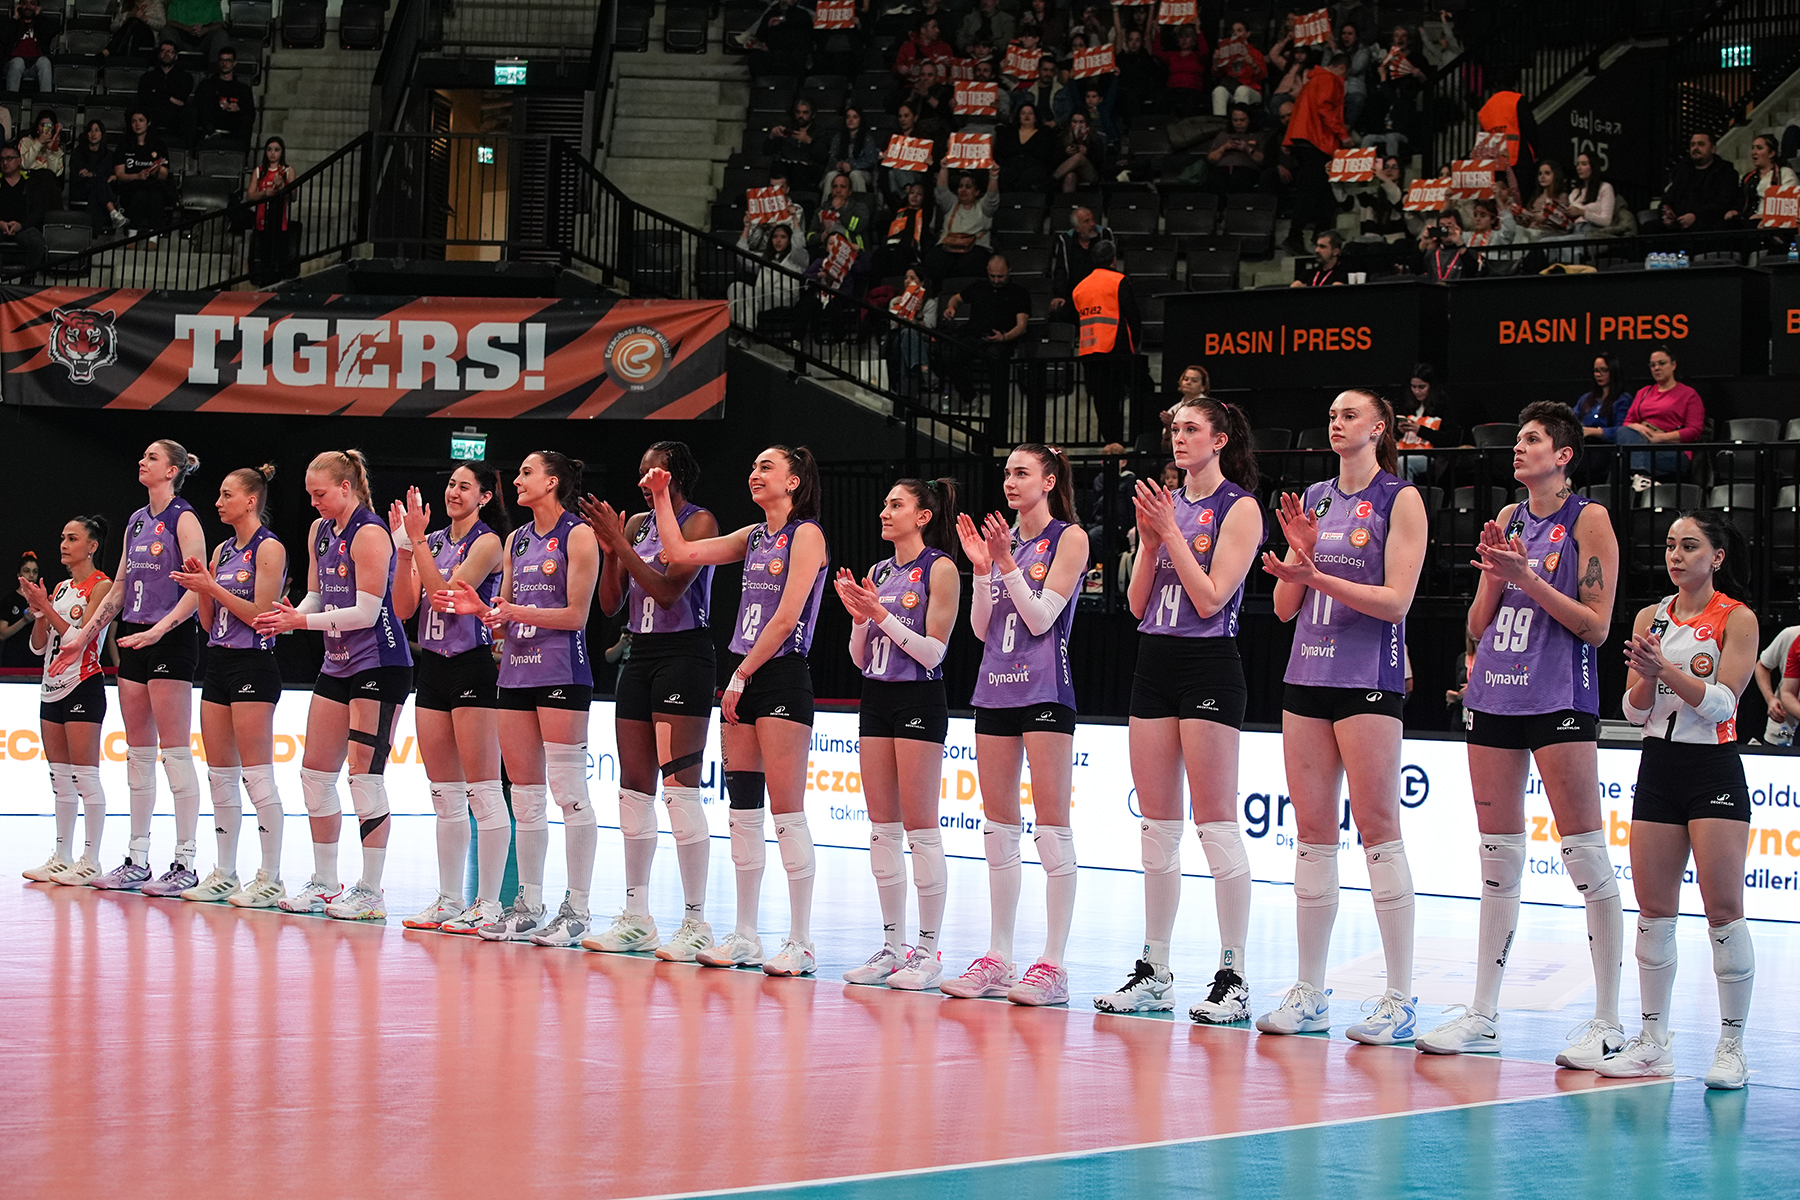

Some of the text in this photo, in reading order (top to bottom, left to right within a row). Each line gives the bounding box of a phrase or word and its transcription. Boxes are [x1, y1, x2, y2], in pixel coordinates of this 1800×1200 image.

[1205, 326, 1372, 355] BASIN PRESS
[1499, 314, 1689, 344] BASIN PRESS
[175, 314, 547, 391] TIGERS!
[1314, 552, 1365, 569] Eczacıbaşı
[133, 580, 143, 612] 3
[1155, 584, 1182, 628] 14
[1311, 588, 1334, 626] 11
[218, 606, 229, 639] 9
[381, 606, 397, 649] PEGASUS
[425, 606, 445, 641] 15
[640, 596, 656, 633] 8
[741, 603, 763, 641] 12
[1493, 606, 1534, 653] 99
[1002, 613, 1018, 654] 6
[510, 653, 543, 667] Dynavit
[868, 635, 891, 675] 10
[1301, 642, 1336, 660] Dynavit
[988, 670, 1030, 687] Dynavit
[1485, 669, 1530, 688] Dynavit
[1665, 710, 1678, 742] 1
[1744, 868, 1800, 891] dileri
